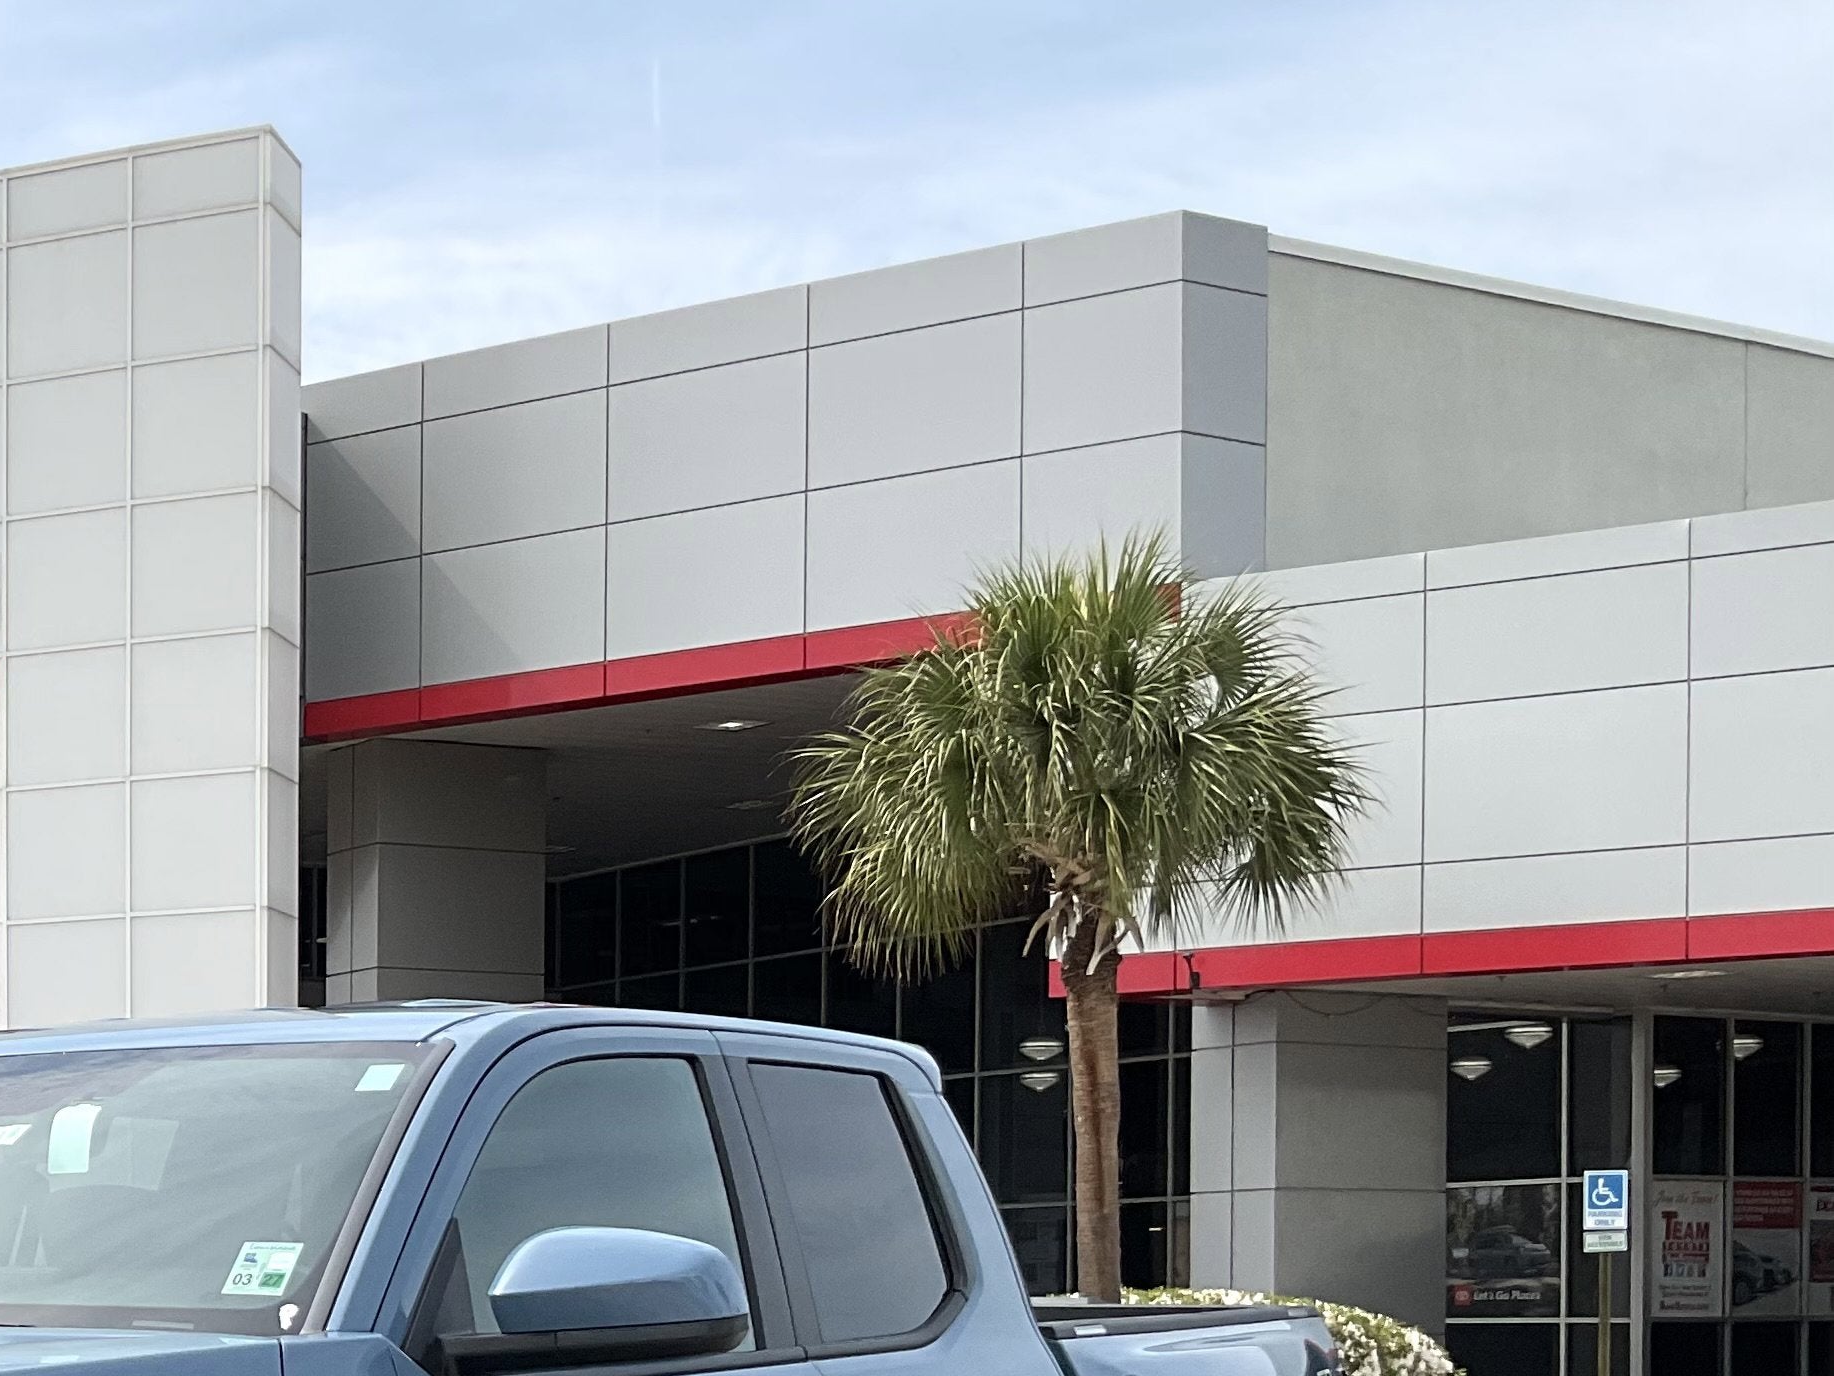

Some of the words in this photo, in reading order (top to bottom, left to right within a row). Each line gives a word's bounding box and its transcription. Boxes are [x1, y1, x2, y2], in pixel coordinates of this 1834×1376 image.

[1662, 1211, 1710, 1240] TEAM
[232, 1273, 253, 1286] 03
[261, 1272, 286, 1287] 27
